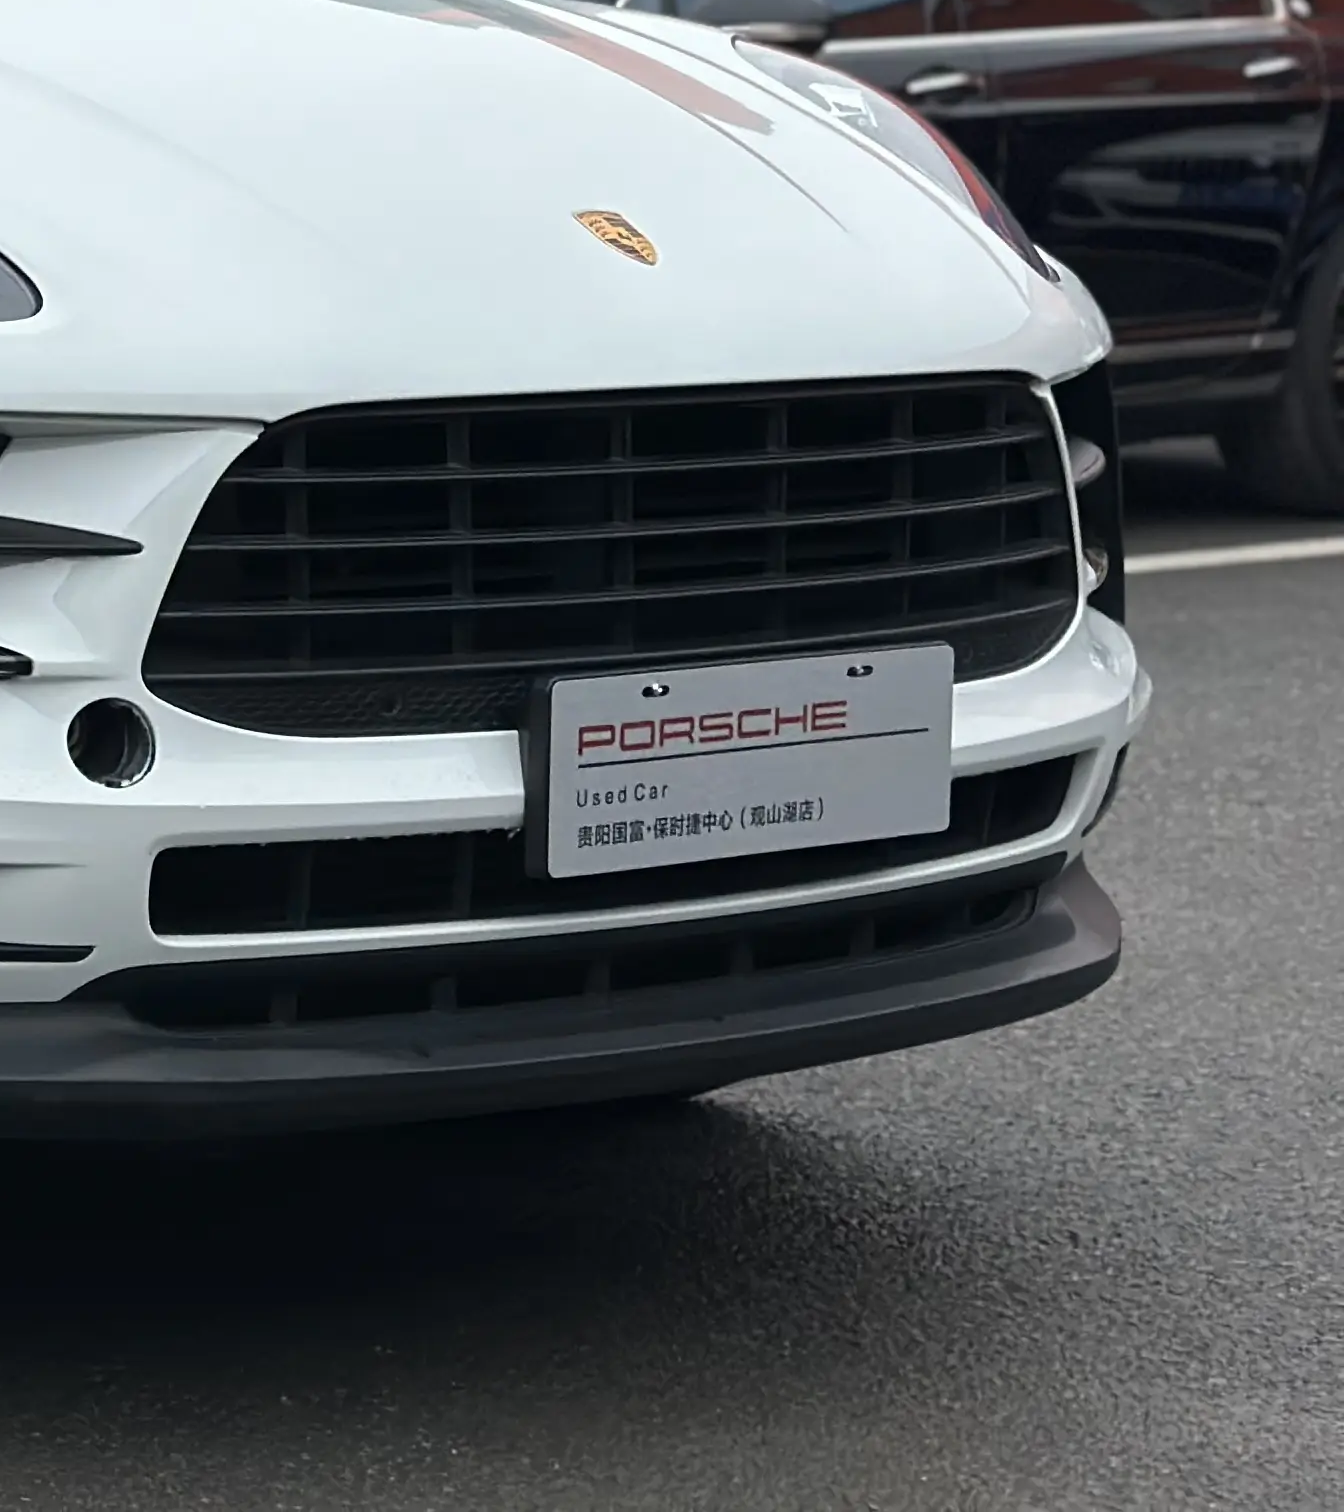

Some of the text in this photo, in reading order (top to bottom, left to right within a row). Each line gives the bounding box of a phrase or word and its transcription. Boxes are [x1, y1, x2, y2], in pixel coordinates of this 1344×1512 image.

[577, 700, 848, 756] PORSCHE
[576, 782, 669, 808] Used Car
